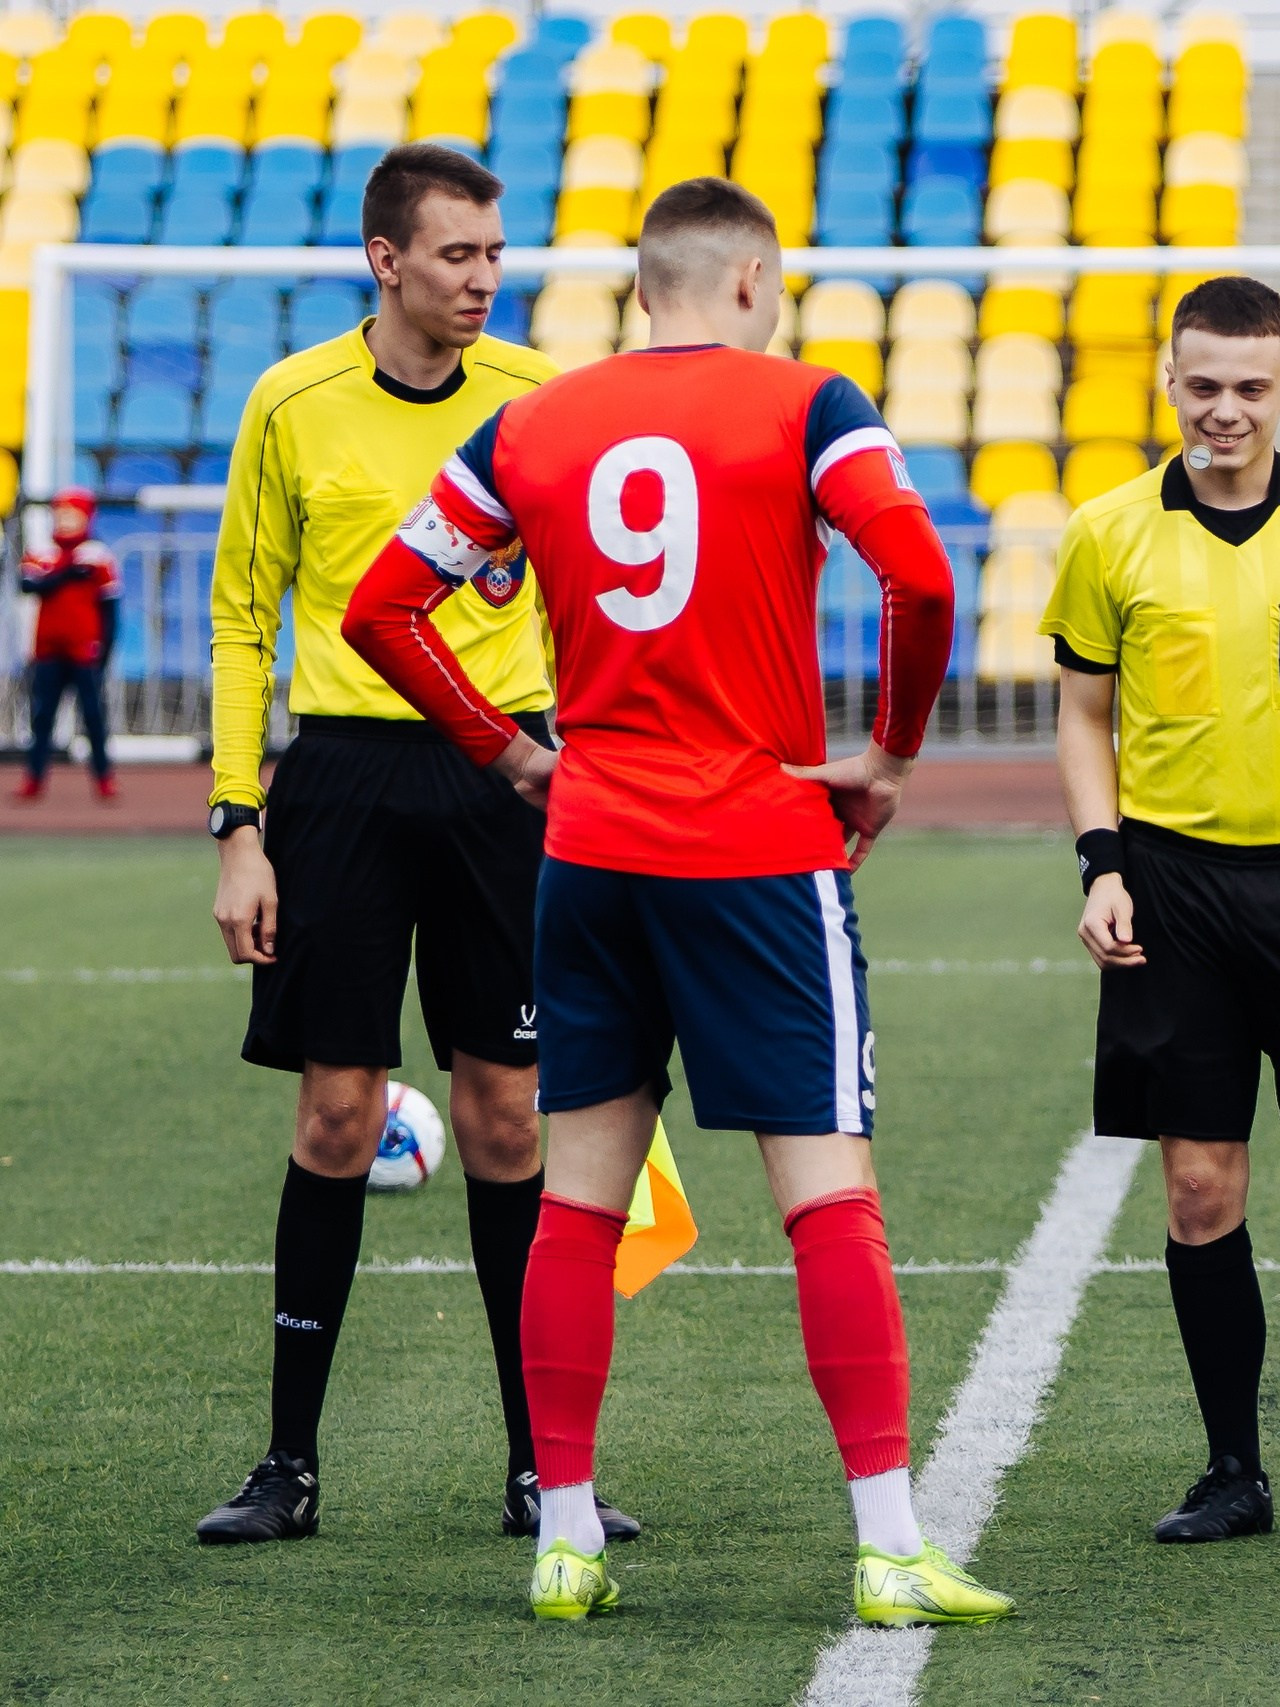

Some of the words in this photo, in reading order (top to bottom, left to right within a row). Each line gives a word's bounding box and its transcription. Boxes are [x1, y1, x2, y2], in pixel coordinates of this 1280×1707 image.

[588, 436, 699, 632] 9
[513, 1027, 538, 1040] ÖGE
[274, 1312, 323, 1330] JÖGEL
